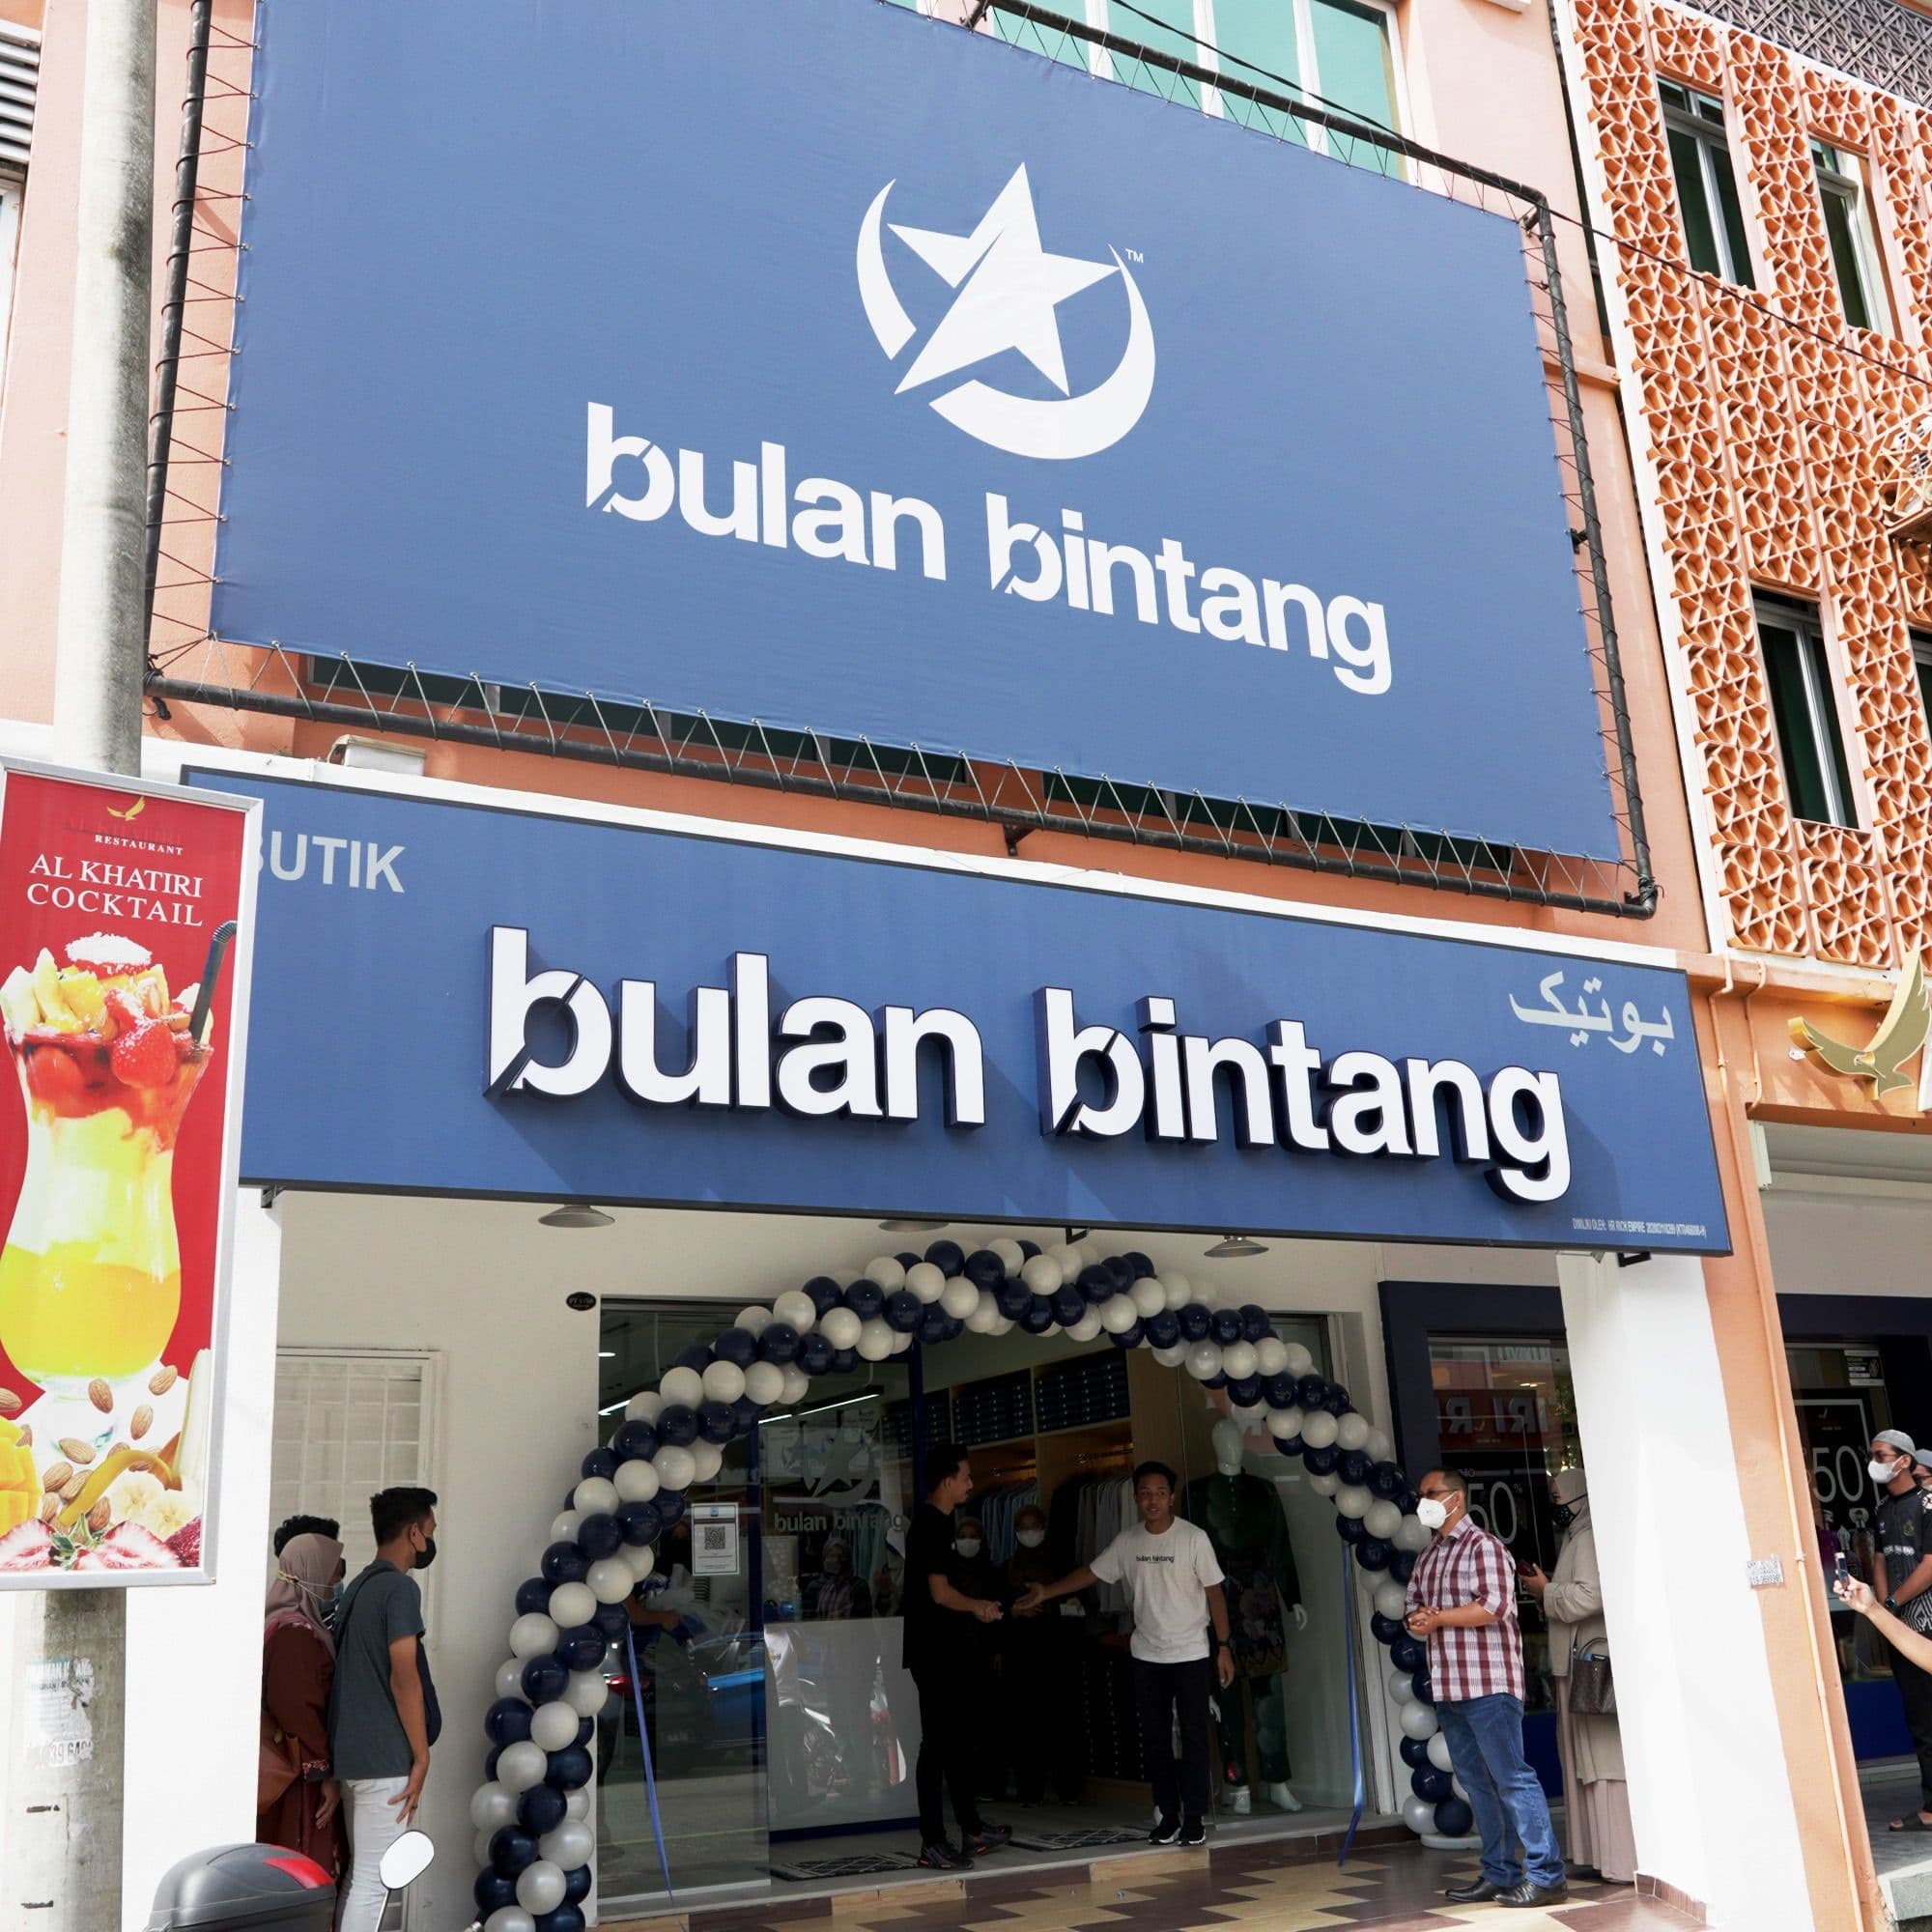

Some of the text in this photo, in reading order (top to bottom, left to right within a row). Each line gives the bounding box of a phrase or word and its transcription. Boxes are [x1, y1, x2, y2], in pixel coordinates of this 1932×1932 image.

[1124, 247, 1144, 264] TM
[586, 401, 1392, 695] bulan bintang
[95, 834, 184, 856] RESTAURANT
[257, 831, 407, 893] UTIK
[30, 854, 202, 898] AL KHATIRI
[26, 883, 202, 926] COCKTAIL
[488, 924, 1572, 1203] bulan bintang
[774, 1512, 828, 1531] bulan
